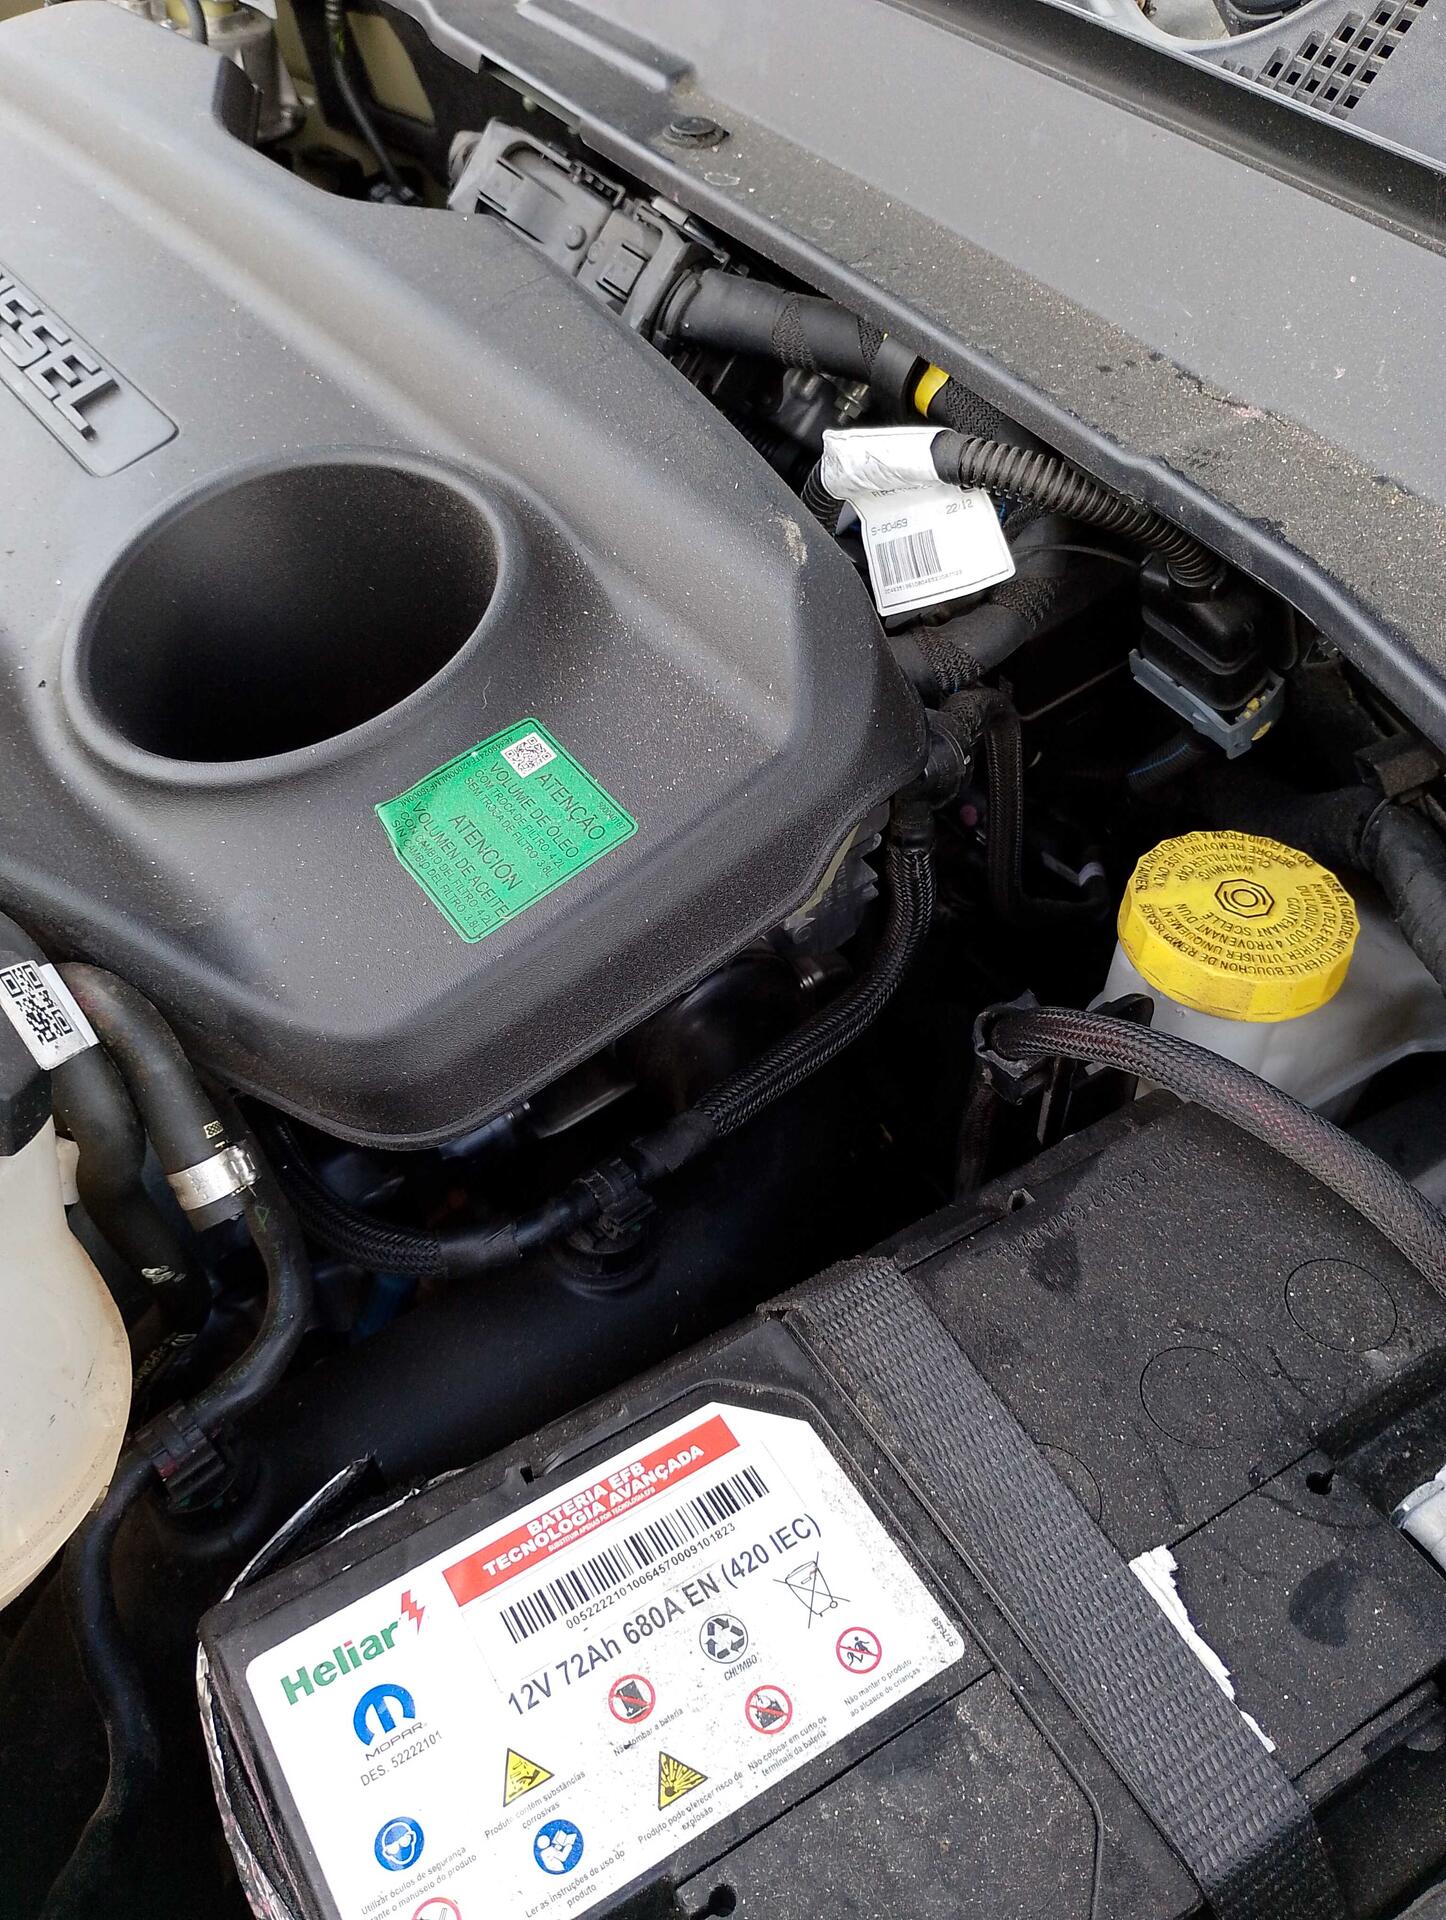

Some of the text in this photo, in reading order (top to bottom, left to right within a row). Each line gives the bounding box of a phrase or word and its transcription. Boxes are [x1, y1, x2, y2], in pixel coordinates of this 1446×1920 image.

[465, 778, 555, 878] SEM TROCA DE FILTRO: 3.8L
[475, 771, 567, 870] COM TROCA DE FILTRO: 4.2L
[489, 764, 581, 859] VOLUME DE ÓLEO
[535, 772, 607, 842] ATENÇÃO
[452, 812, 523, 891] ATENCIÓN
[1160, 834, 1199, 851] SEALED
[1198, 832, 1208, 840] A
[1211, 831, 1244, 840] FROM
[1248, 835, 1281, 850] FLUID
[1248, 846, 1296, 868] BEFORE
[392, 821, 408, 838] SIN
[403, 839, 430, 870] CAMBIO
[428, 869, 443, 886] DEL
[464, 914, 482, 933] 3.8L
[400, 812, 493, 927] CON CAMBIO DEL FILTRO: 4.2L
[411, 802, 508, 917] VOLUMEN DE ACEITE
[1153, 867, 1170, 889] ONLY
[1164, 853, 1184, 867] USE
[1175, 853, 1270, 881] CLEAN FILLER CAP
[1310, 884, 1335, 910] AVANT
[1321, 874, 1343, 895] MISE
[1335, 896, 1349, 907] EN
[1159, 907, 1222, 954] UNIQUEMENT
[1175, 886, 1318, 950] DU LIQUIDE DOT 4 PROVENANT D'UN
[1257, 898, 1300, 937] CONTENANT
[1320, 924, 1335, 936] LE
[1323, 912, 1336, 925] DE
[1199, 953, 1218, 966] DE
[1219, 961, 1284, 976] BOUCHON
[1226, 950, 1282, 963] UTILISER
[1285, 965, 1302, 976] LE
[1300, 938, 1348, 971] NETTOYER
[482, 1443, 704, 1577] TECNOLOGIA AVANÇADA
[527, 1460, 645, 1536] BATERIA EFB
[578, 1517, 600, 1533] APENAS
[599, 1511, 611, 1521] POR
[611, 1492, 644, 1515] TECNOLOGIA
[565, 1522, 735, 1629] 00522221010064570009101823
[507, 1510, 821, 1716] 12V 72Ah 680A EN (420 IEC)
[281, 1617, 402, 1703] Heliar
[723, 1654, 757, 1681] CHUMBO
[844, 1693, 857, 1705] Não
[858, 1679, 880, 1696] manter
[886, 1658, 911, 1679] produto
[849, 1666, 920, 1716] ao alcance de crianças
[628, 1726, 652, 1746] tombar
[659, 1706, 683, 1726] bateria
[747, 1715, 827, 1771] Não colocar em curto os
[360, 1730, 442, 1785] DES. 52222101
[761, 1729, 825, 1775] terminais da bateria
[515, 1796, 542, 1818] contém
[542, 1769, 585, 1801] substâncias
[522, 1800, 560, 1829] corrosivas
[638, 1769, 743, 1843] Produto pode oferecer risco de
[681, 1804, 713, 1830] explosão
[361, 1845, 466, 1916] Utilizar óculos de segurança
[403, 1879, 435, 1903] manuseio
[435, 1871, 447, 1884] do
[446, 1852, 477, 1877] produto
[525, 1848, 625, 1919] Ler as instruções de uso do
[566, 1883, 597, 1907] produto
